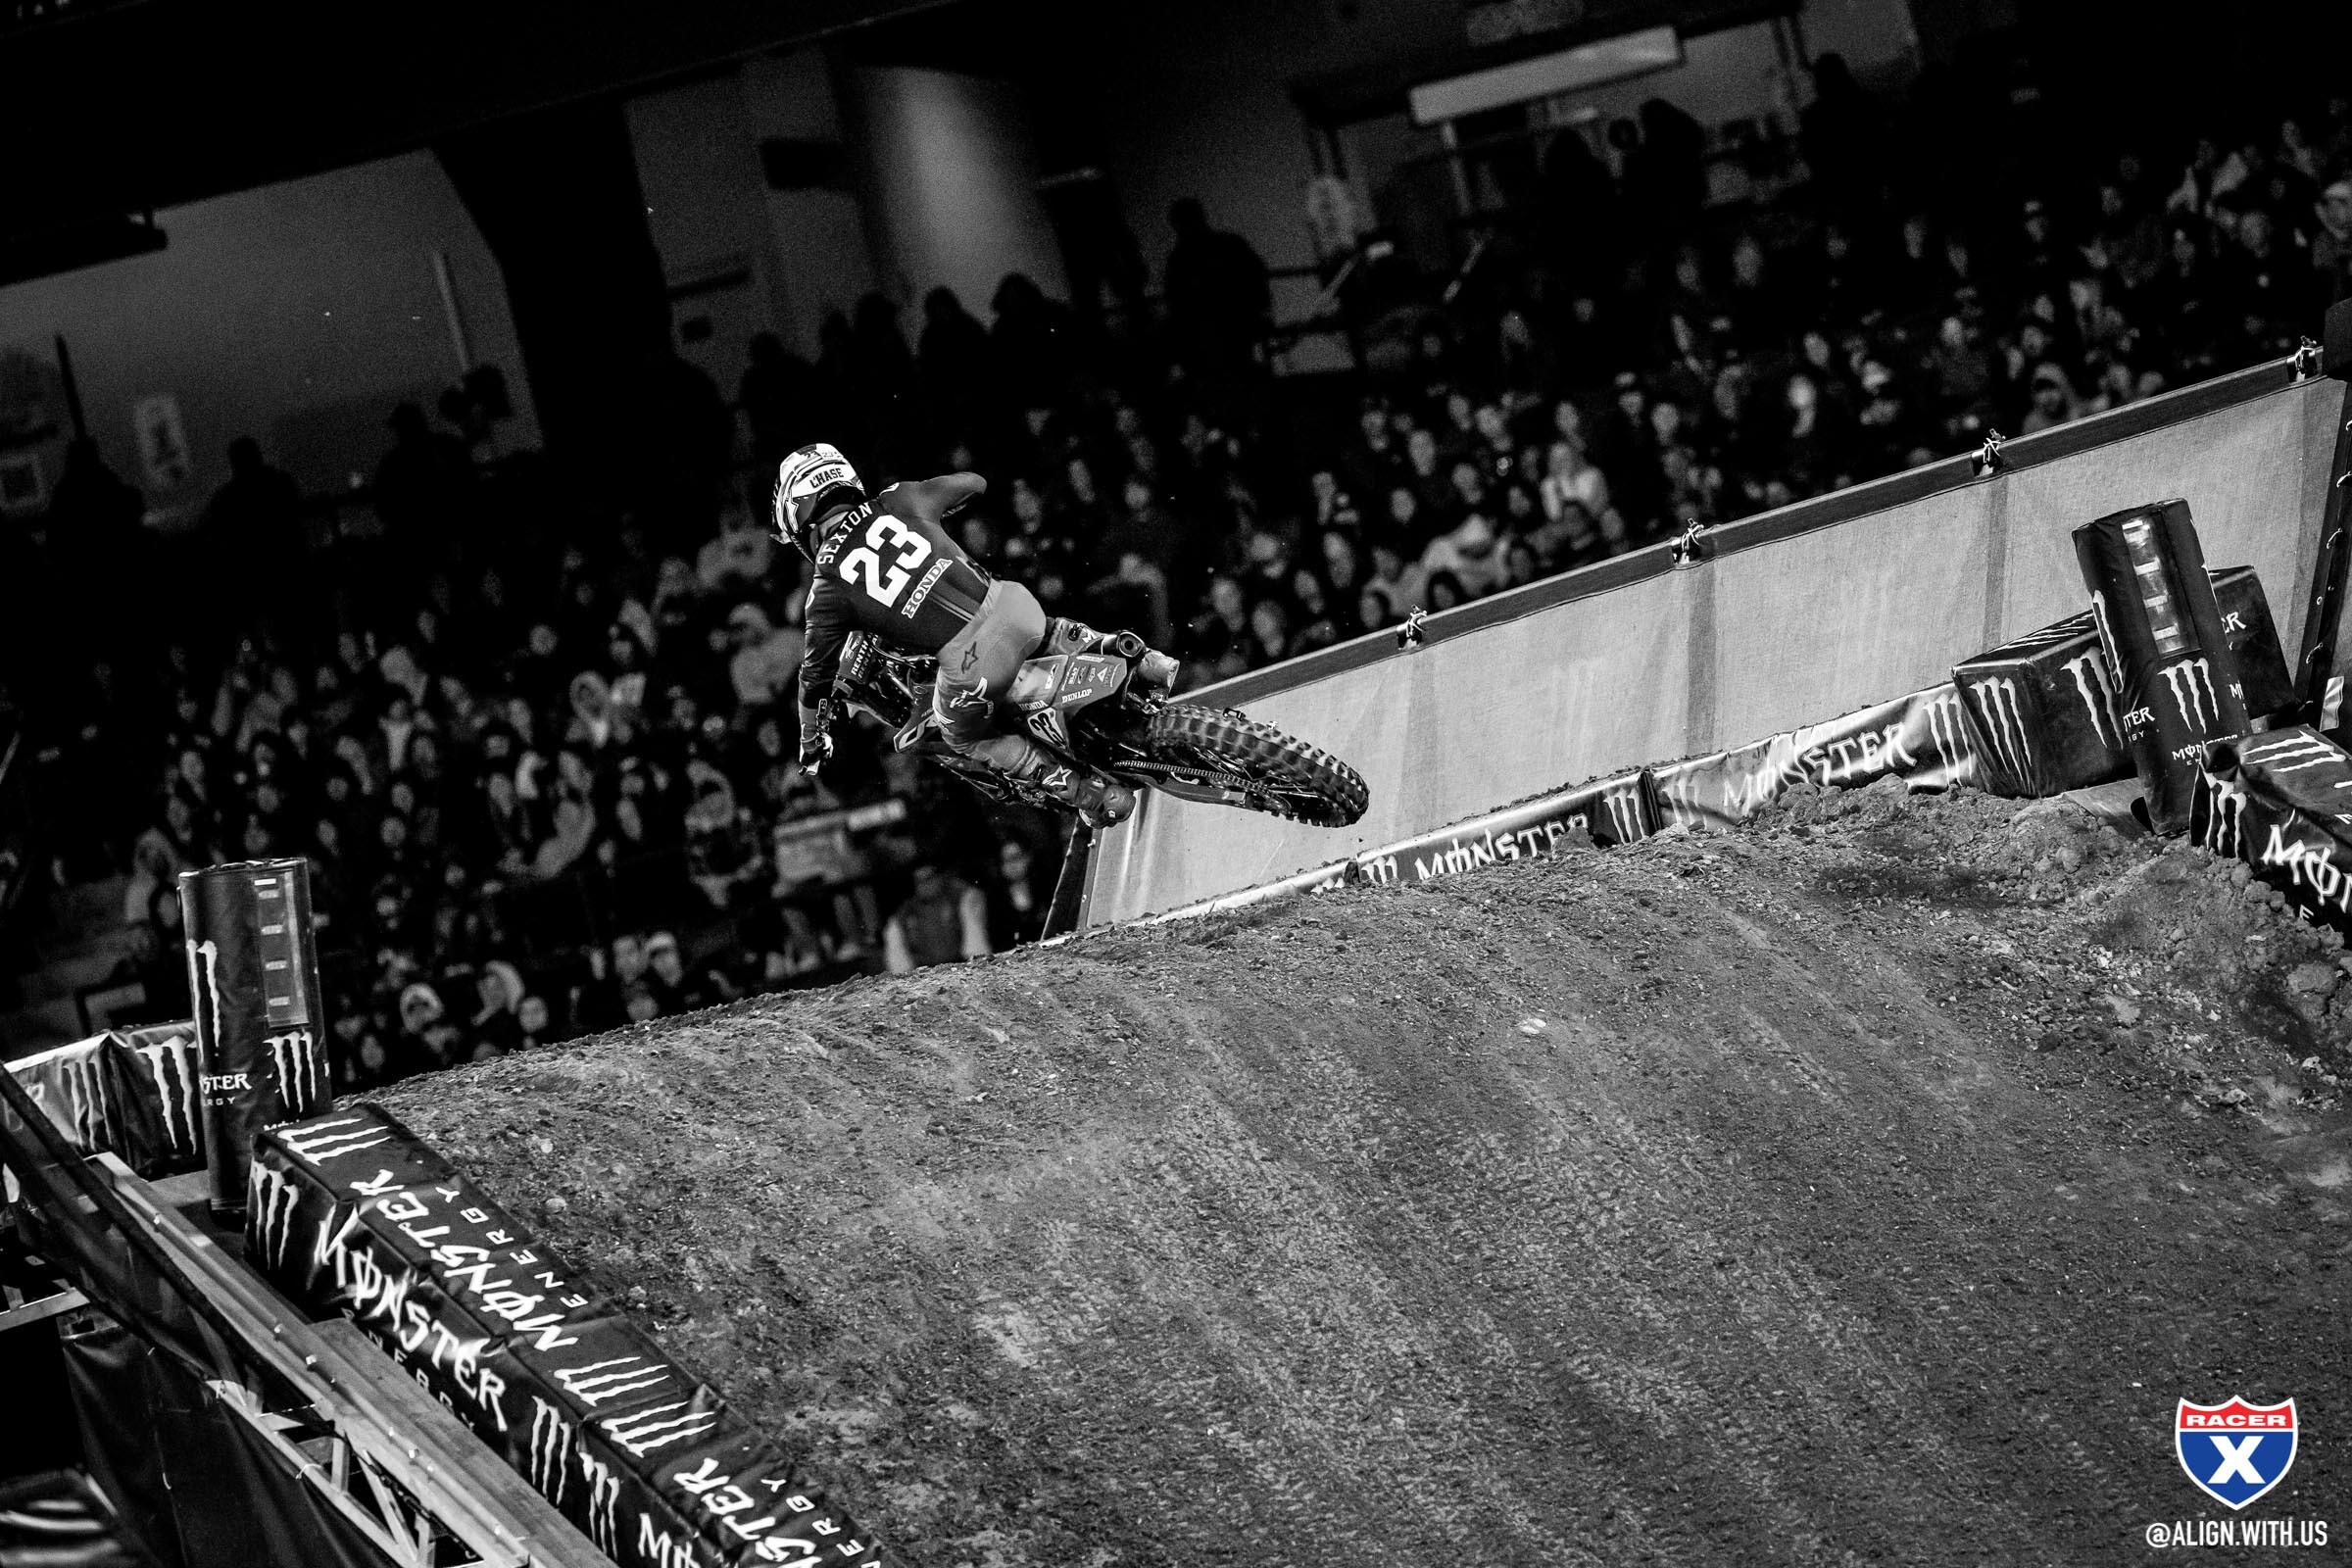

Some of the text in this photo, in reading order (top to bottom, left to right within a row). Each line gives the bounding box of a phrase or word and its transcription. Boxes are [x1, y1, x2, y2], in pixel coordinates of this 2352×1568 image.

[817, 502, 873, 565] SEXTON
[839, 514, 932, 609] 23
[901, 558, 954, 619] HONDA
[1019, 700, 1050, 711] HONDA
[1061, 688, 1093, 704] DUNLOP
[2123, 707, 2156, 733] TER
[1029, 712, 1066, 747] 23
[349, 1168, 579, 1352] MONSTER
[435, 1186, 589, 1309] ENERGY
